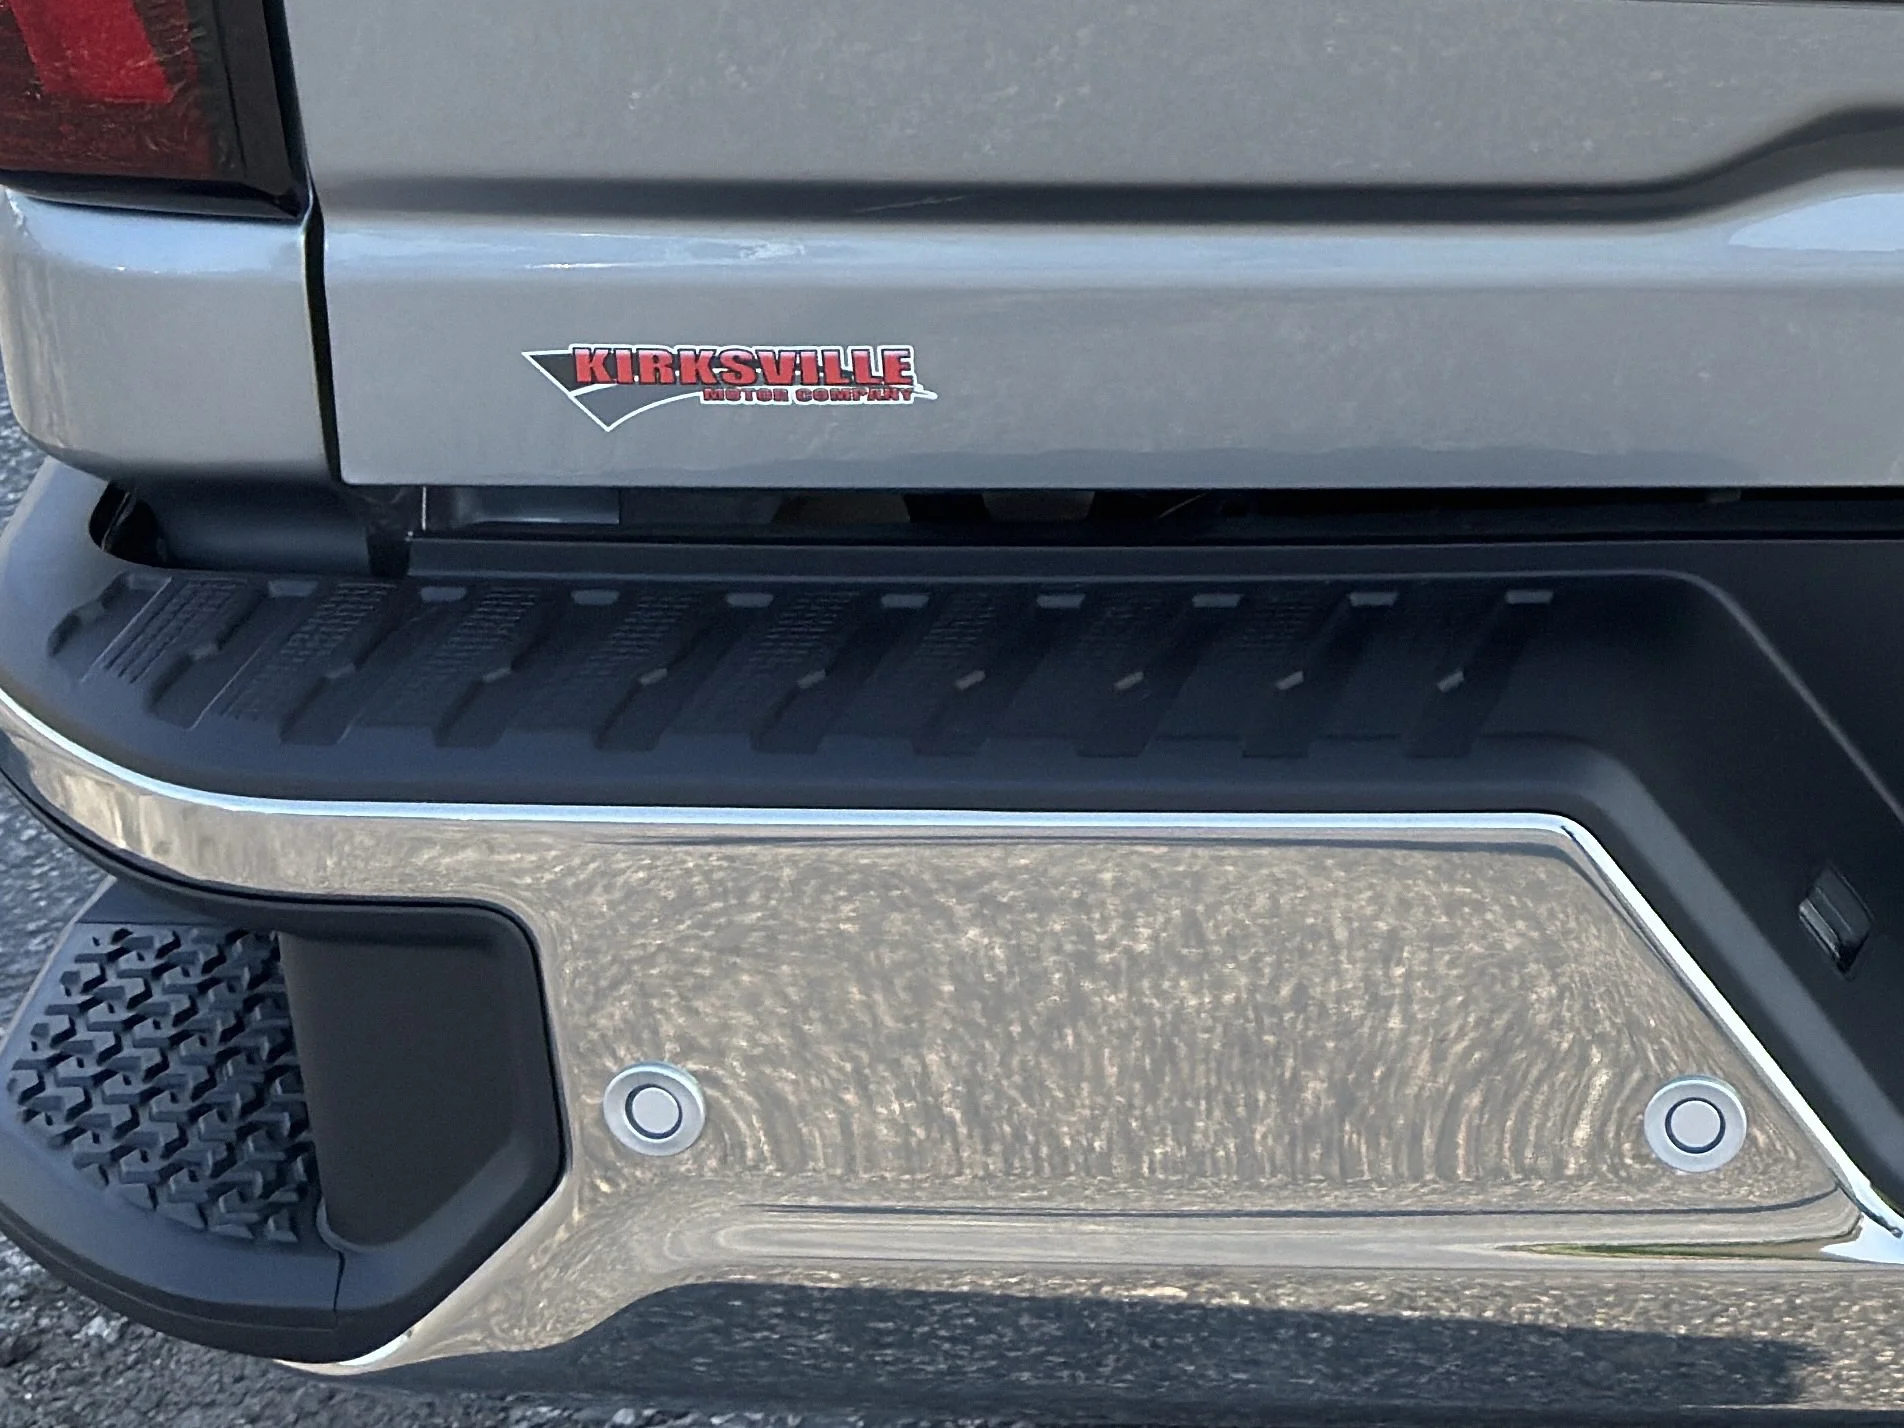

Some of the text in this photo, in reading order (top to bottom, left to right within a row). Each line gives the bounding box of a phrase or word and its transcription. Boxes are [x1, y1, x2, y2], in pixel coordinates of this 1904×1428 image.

[571, 346, 914, 386] KIRKSVILLE
[702, 386, 915, 403] MOTOR COMPANY
